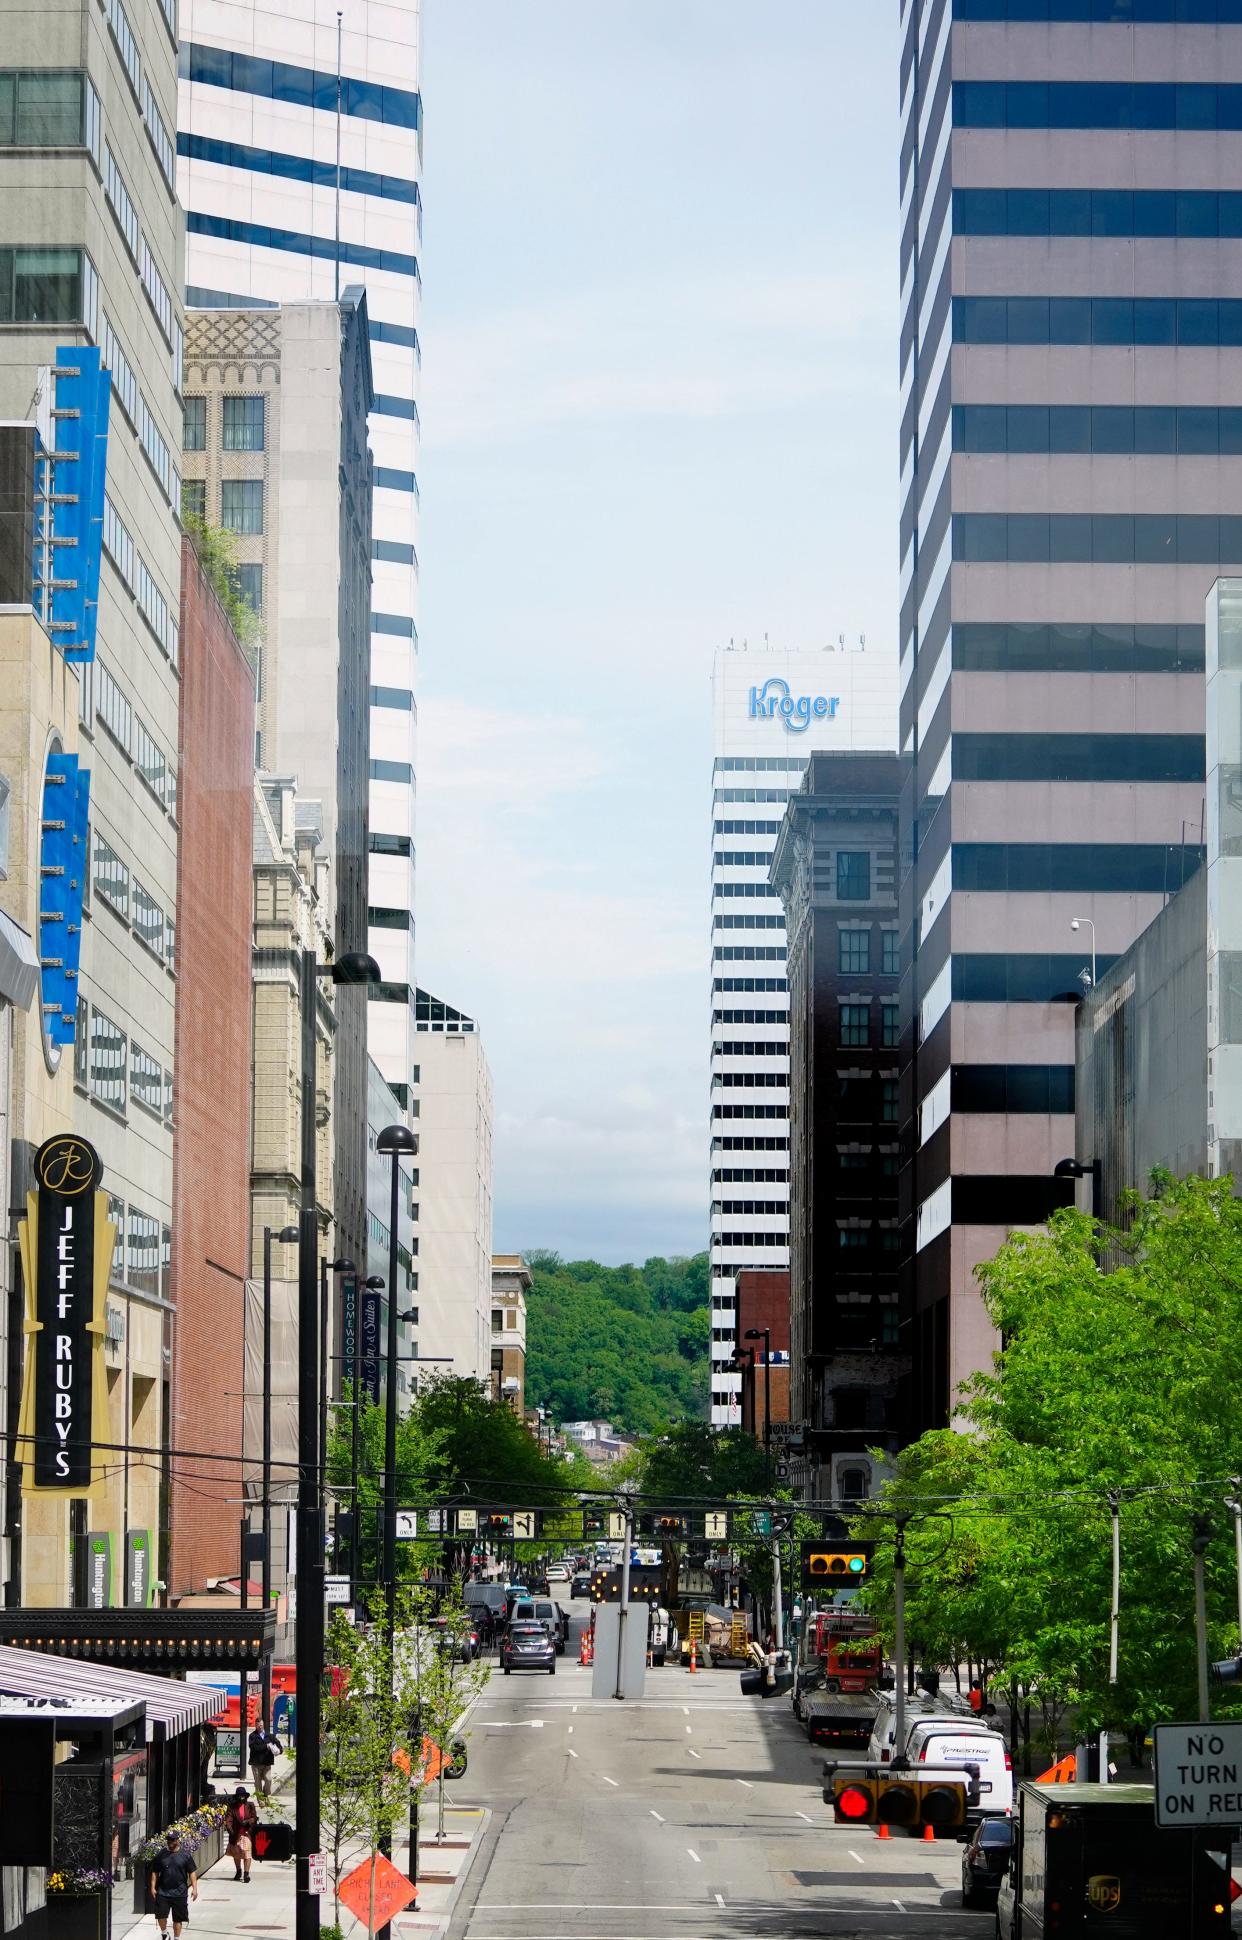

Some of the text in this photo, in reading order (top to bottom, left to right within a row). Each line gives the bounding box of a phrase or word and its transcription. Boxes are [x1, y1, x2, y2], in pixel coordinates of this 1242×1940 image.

[751, 678, 840, 732] Kroger
[56, 1206, 75, 1319] JEFF
[92, 1554, 106, 1608] Huntington
[132, 1550, 145, 1603] Huntington
[1187, 1736, 1225, 1756] NO
[1177, 1765, 1237, 1785] TURN
[1165, 1794, 1194, 1814] ON
[312, 1868, 324, 1877] ANY
[1091, 1886, 1118, 1907] ups
